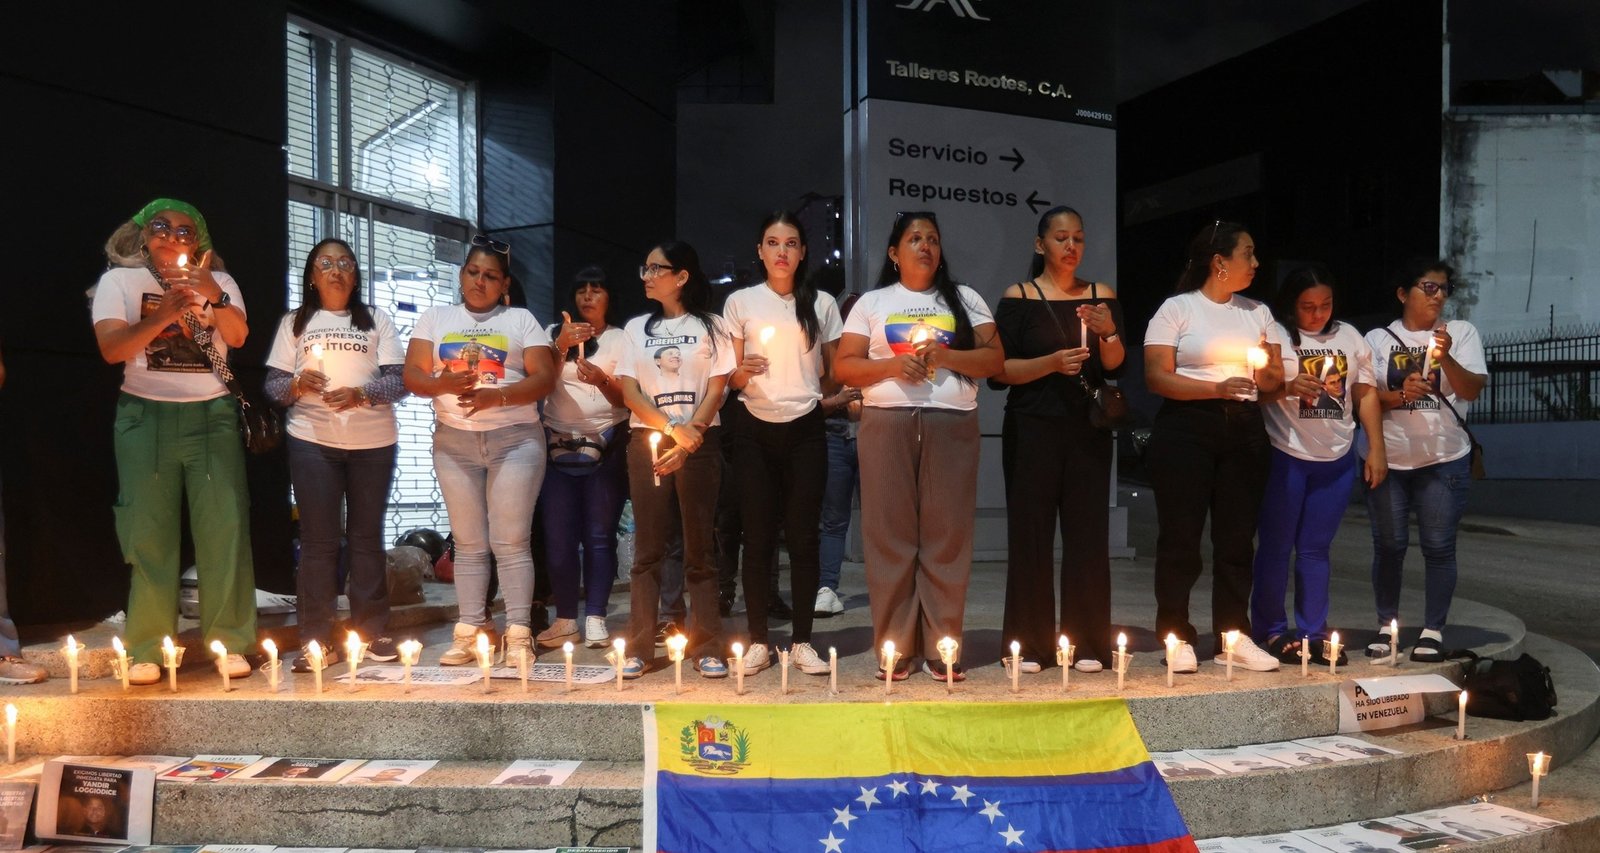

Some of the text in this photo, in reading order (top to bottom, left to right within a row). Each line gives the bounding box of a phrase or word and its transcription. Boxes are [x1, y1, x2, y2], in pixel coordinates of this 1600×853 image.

[886, 60, 1072, 98] Talleres Rootes, C.A.
[888, 138, 988, 165] Servicio
[889, 178, 1018, 207] Repuestos
[303, 332, 368, 343] LOS PRESOS
[648, 336, 685, 346] LIBEREN
[303, 339, 368, 356] PÍTICOS
[1355, 693, 1410, 708] HA SIDO LIBERADO
[1356, 705, 1408, 721] EN VENEZUELA
[74, 786, 117, 796] LOGGIODICE
[82, 780, 110, 789] YANDIR
